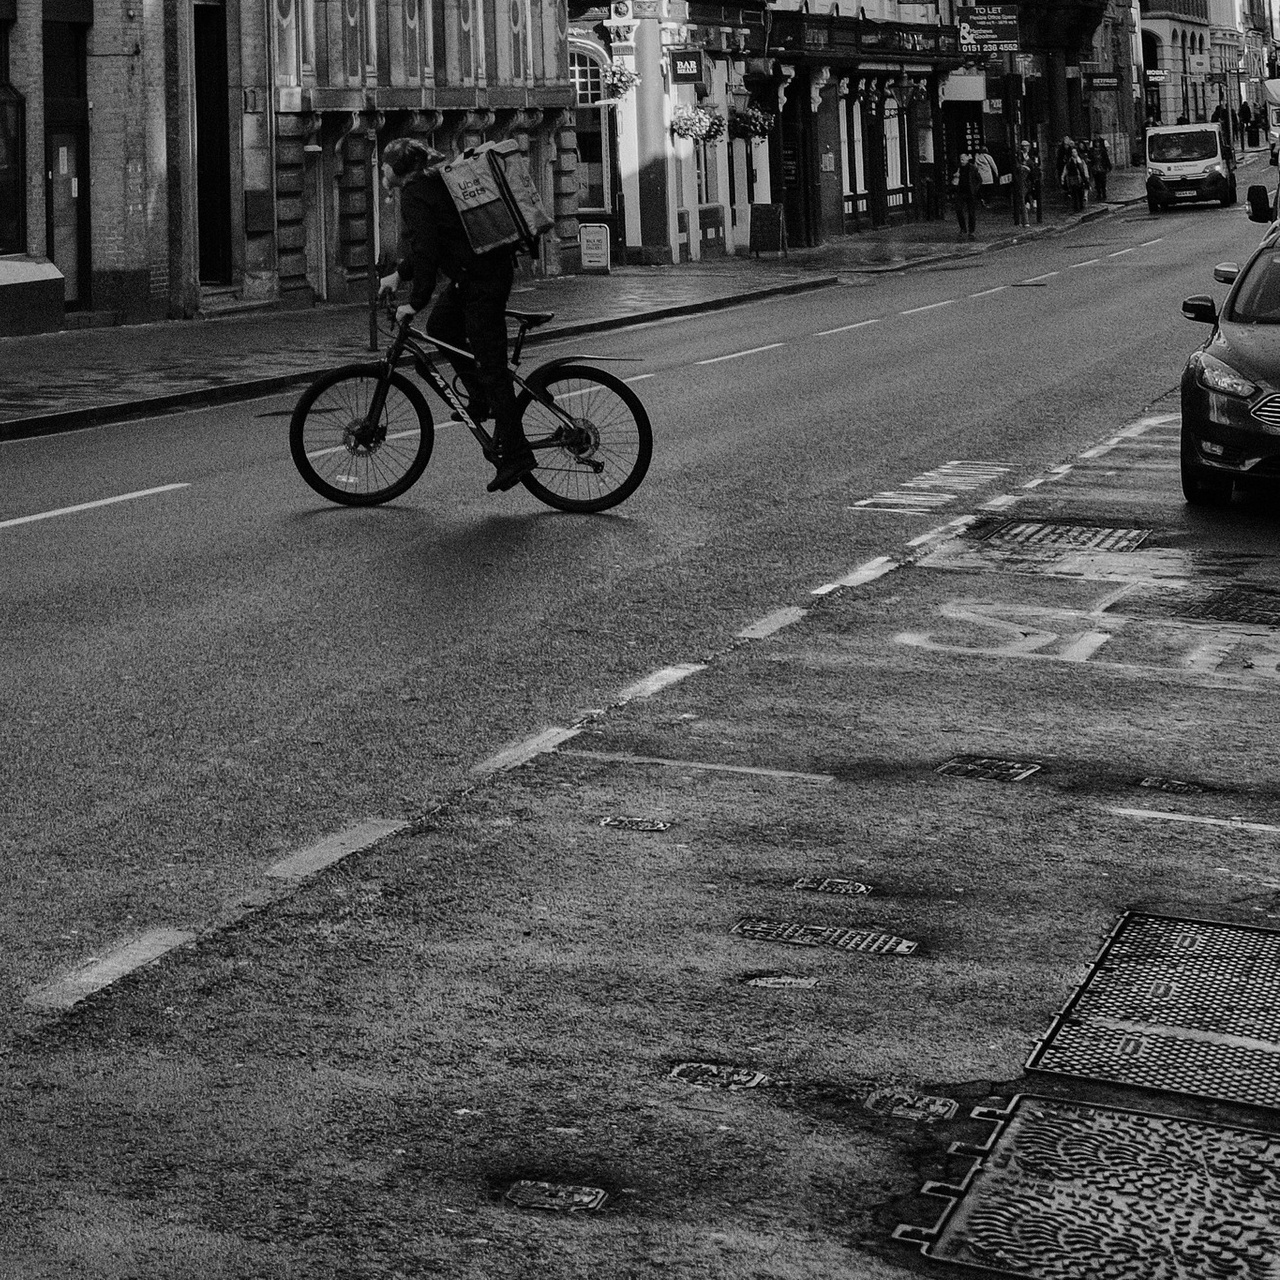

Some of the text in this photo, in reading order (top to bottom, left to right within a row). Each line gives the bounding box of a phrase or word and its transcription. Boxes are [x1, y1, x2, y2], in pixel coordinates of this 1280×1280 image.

[987, 6, 1002, 14] LET
[962, 44, 981, 52] 0151
[998, 43, 1018, 51] 4552
[676, 60, 697, 69] BAR
[462, 186, 487, 201] Eats
